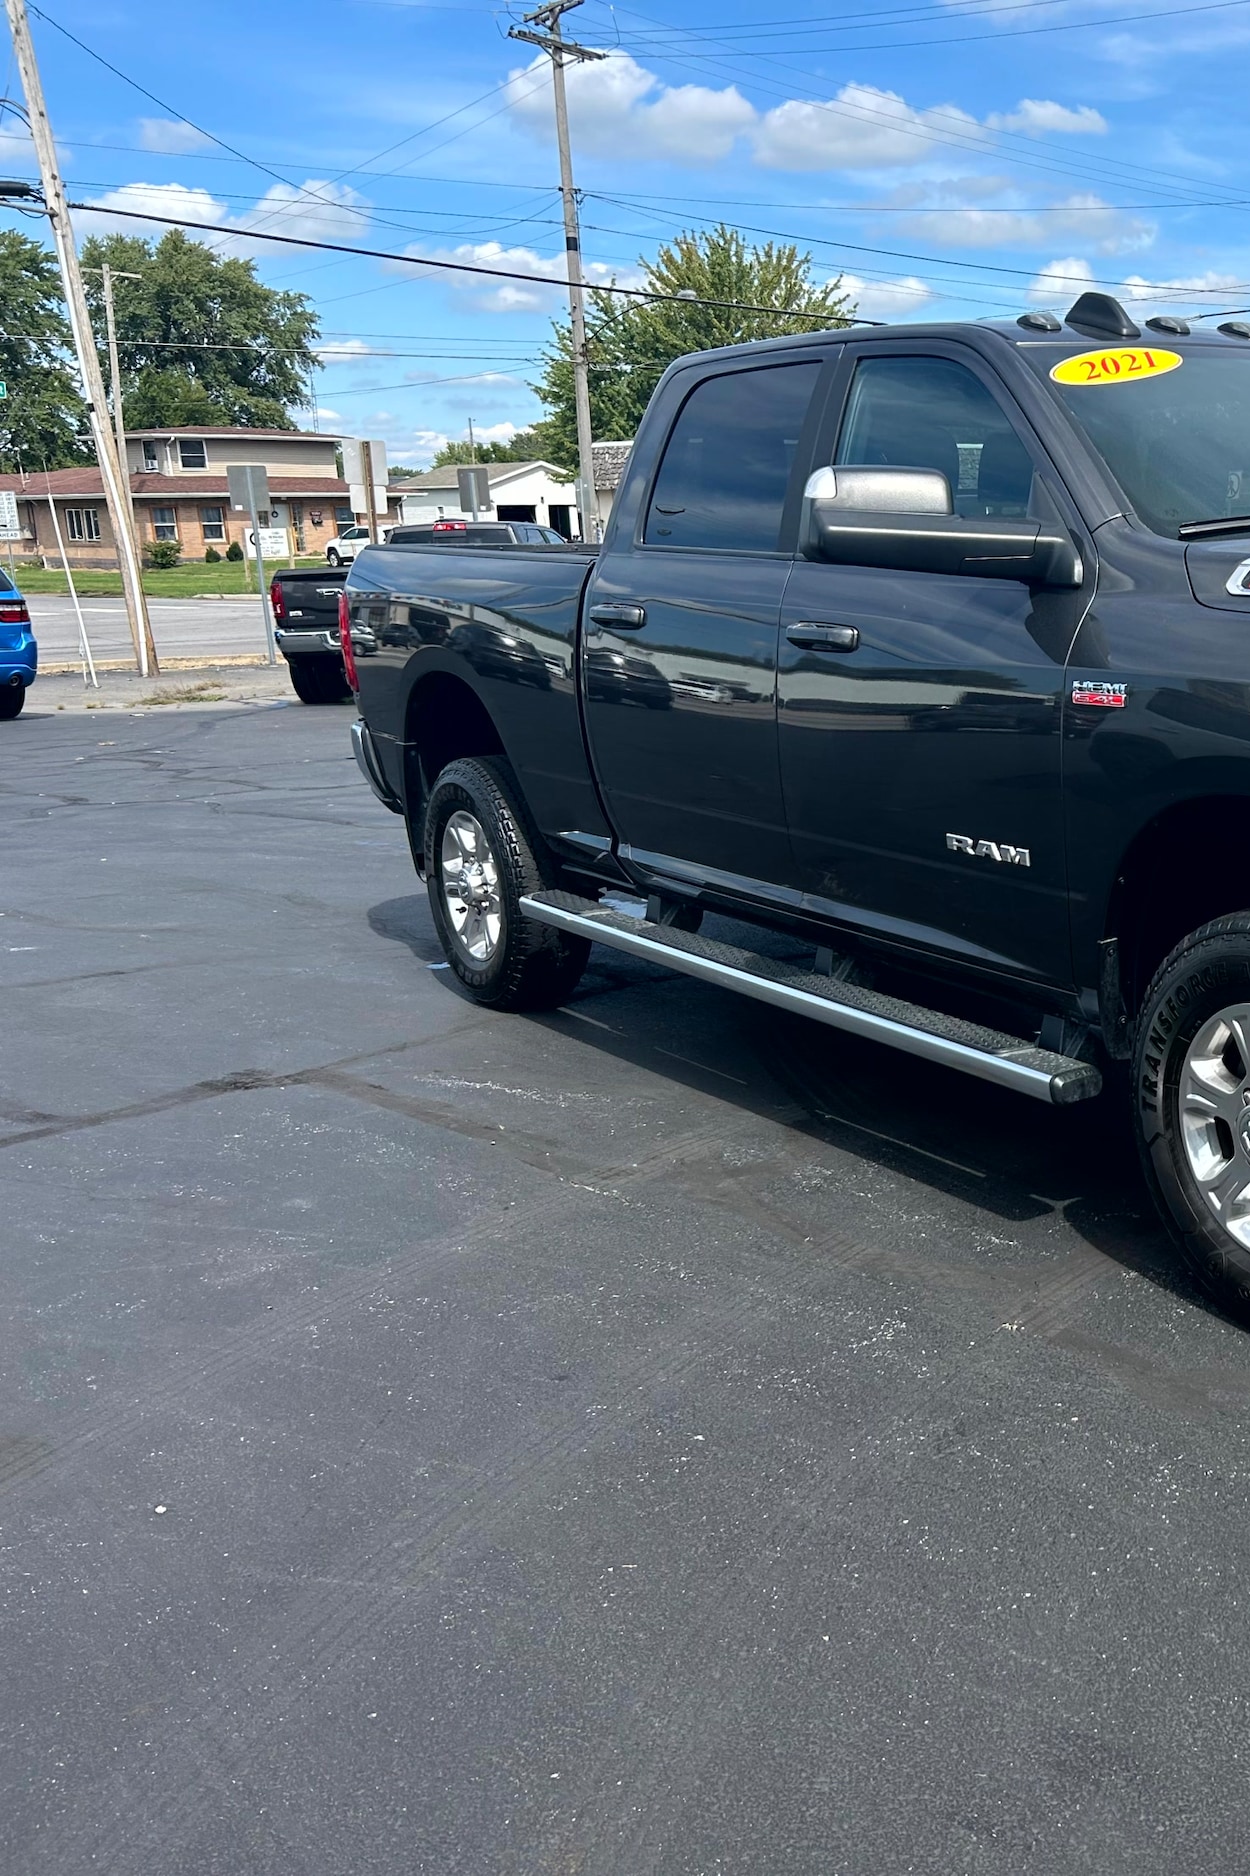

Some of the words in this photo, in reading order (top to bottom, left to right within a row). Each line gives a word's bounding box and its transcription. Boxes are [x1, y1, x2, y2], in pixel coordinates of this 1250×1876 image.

[1079, 351, 1158, 381] 2021
[1073, 681, 1128, 695] HEMI
[946, 833, 1031, 867] RAM
[1141, 960, 1230, 1113] TRANSFORCE
